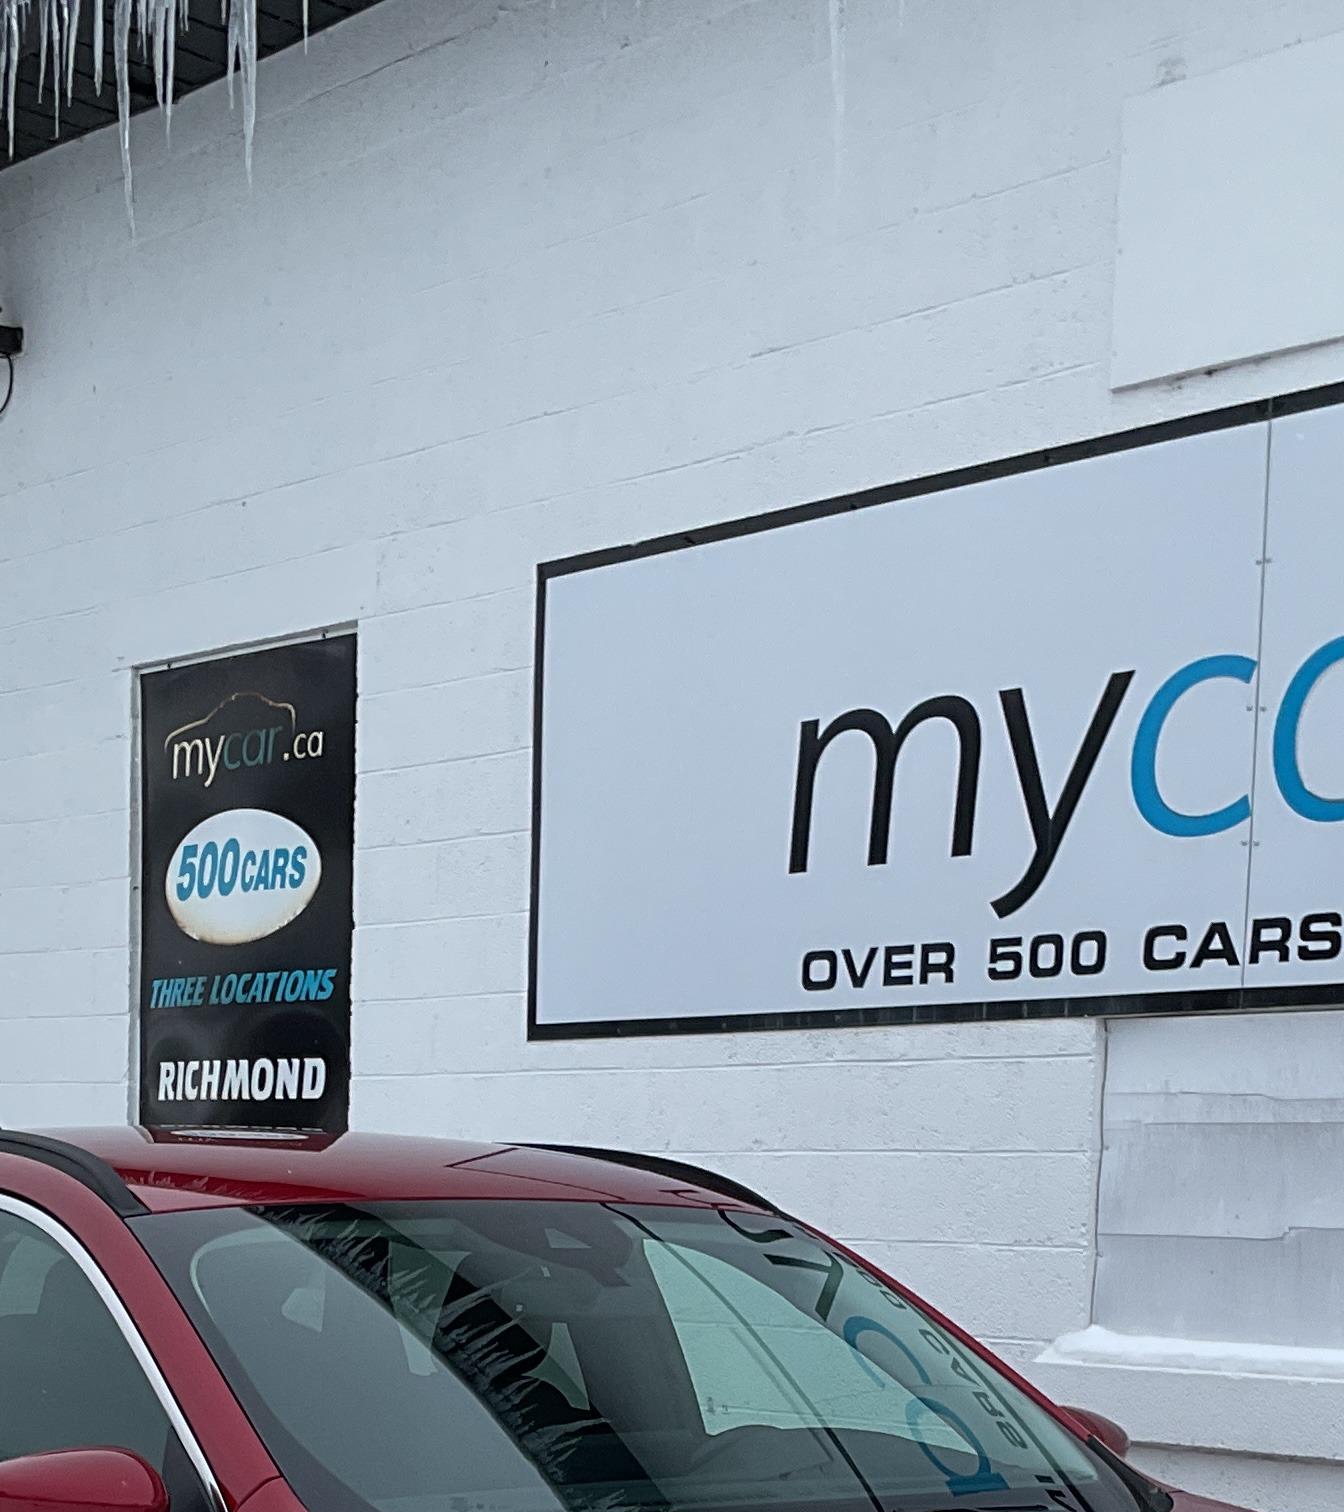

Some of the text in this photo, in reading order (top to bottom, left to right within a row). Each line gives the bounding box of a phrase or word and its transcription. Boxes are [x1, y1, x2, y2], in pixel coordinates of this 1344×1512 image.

[173, 725, 323, 788] mycar.ca
[801, 942, 955, 991] OVER
[987, 930, 1107, 980] 500
[1142, 912, 1343, 972] CARS
[150, 968, 337, 1009] THREE LOCATIONS
[158, 1057, 327, 1101] RICHMOND
